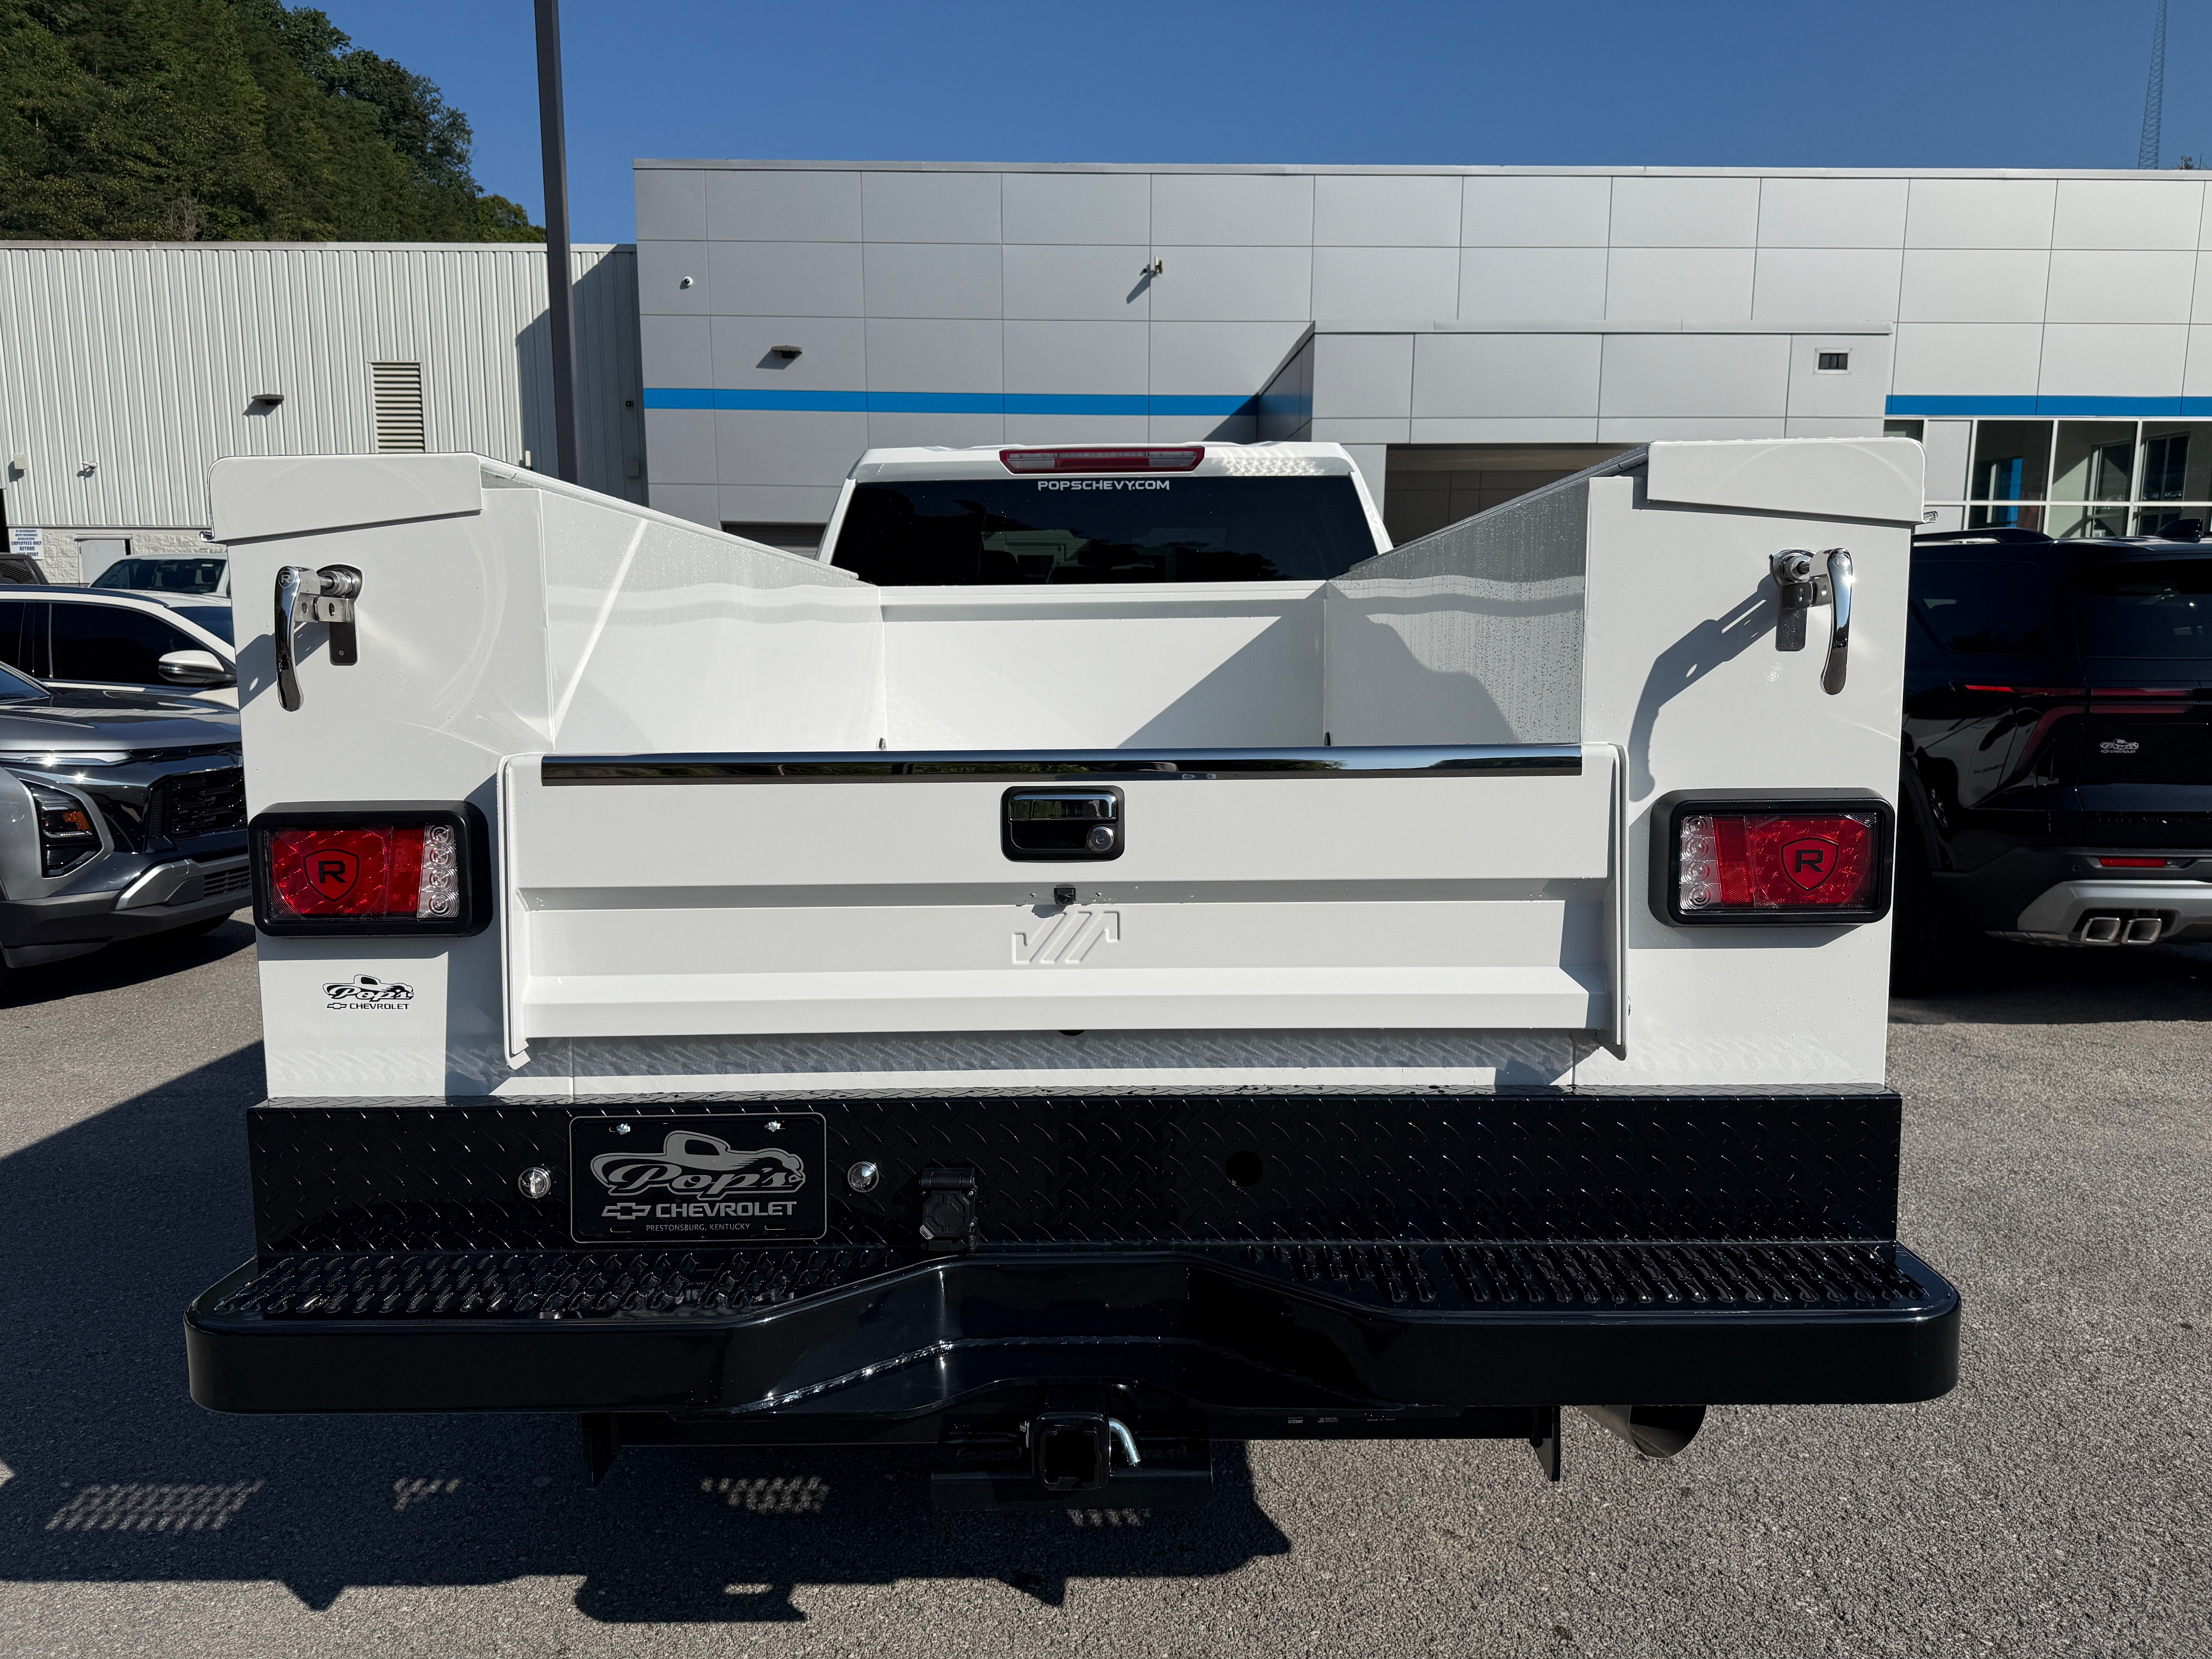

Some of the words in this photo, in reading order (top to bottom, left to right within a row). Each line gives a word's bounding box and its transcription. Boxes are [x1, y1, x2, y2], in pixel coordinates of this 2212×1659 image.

[1038, 480, 1170, 491] POPSCHEVY.COM
[281, 575, 291, 583] R
[1795, 849, 1824, 873] R
[318, 860, 348, 884] R
[329, 986, 410, 1001] Pop's
[608, 1164, 793, 1195] Pop's
[656, 1201, 797, 1218] CHEVROLET
